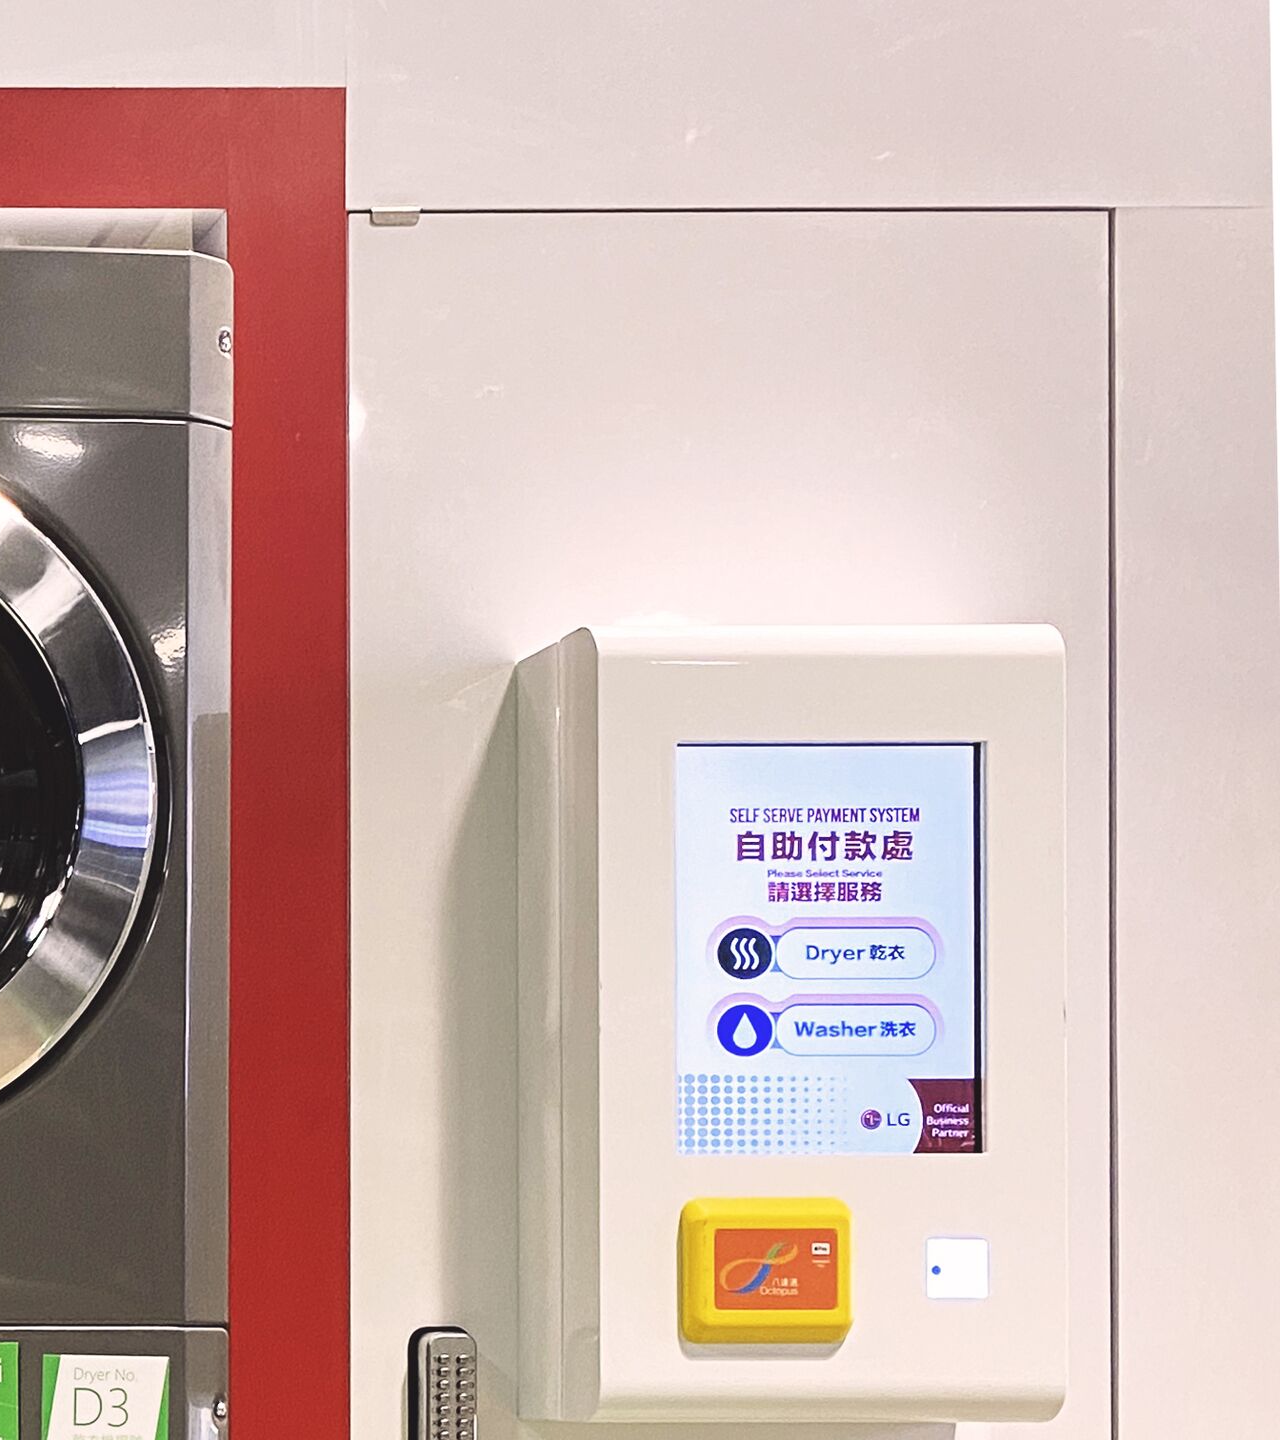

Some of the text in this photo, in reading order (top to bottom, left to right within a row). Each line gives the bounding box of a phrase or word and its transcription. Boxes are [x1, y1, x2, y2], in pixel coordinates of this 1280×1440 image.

[729, 808, 920, 823] SELF SERVE PAYMENT SYSTEM
[737, 831, 914, 862] 自助付款處
[768, 869, 883, 878] Please Select Service
[768, 882, 882, 902] 請選擇服務
[806, 945, 905, 965] Dryer 乾衣
[795, 1021, 916, 1037] Washer 洗衣
[934, 1103, 969, 1113] Official
[887, 1113, 910, 1126] LG
[926, 1116, 969, 1126] Business
[932, 1128, 969, 1138] Partner
[760, 1286, 798, 1296] Octopus
[73, 1368, 138, 1384] Dryer No.
[73, 1388, 129, 1427] D3
